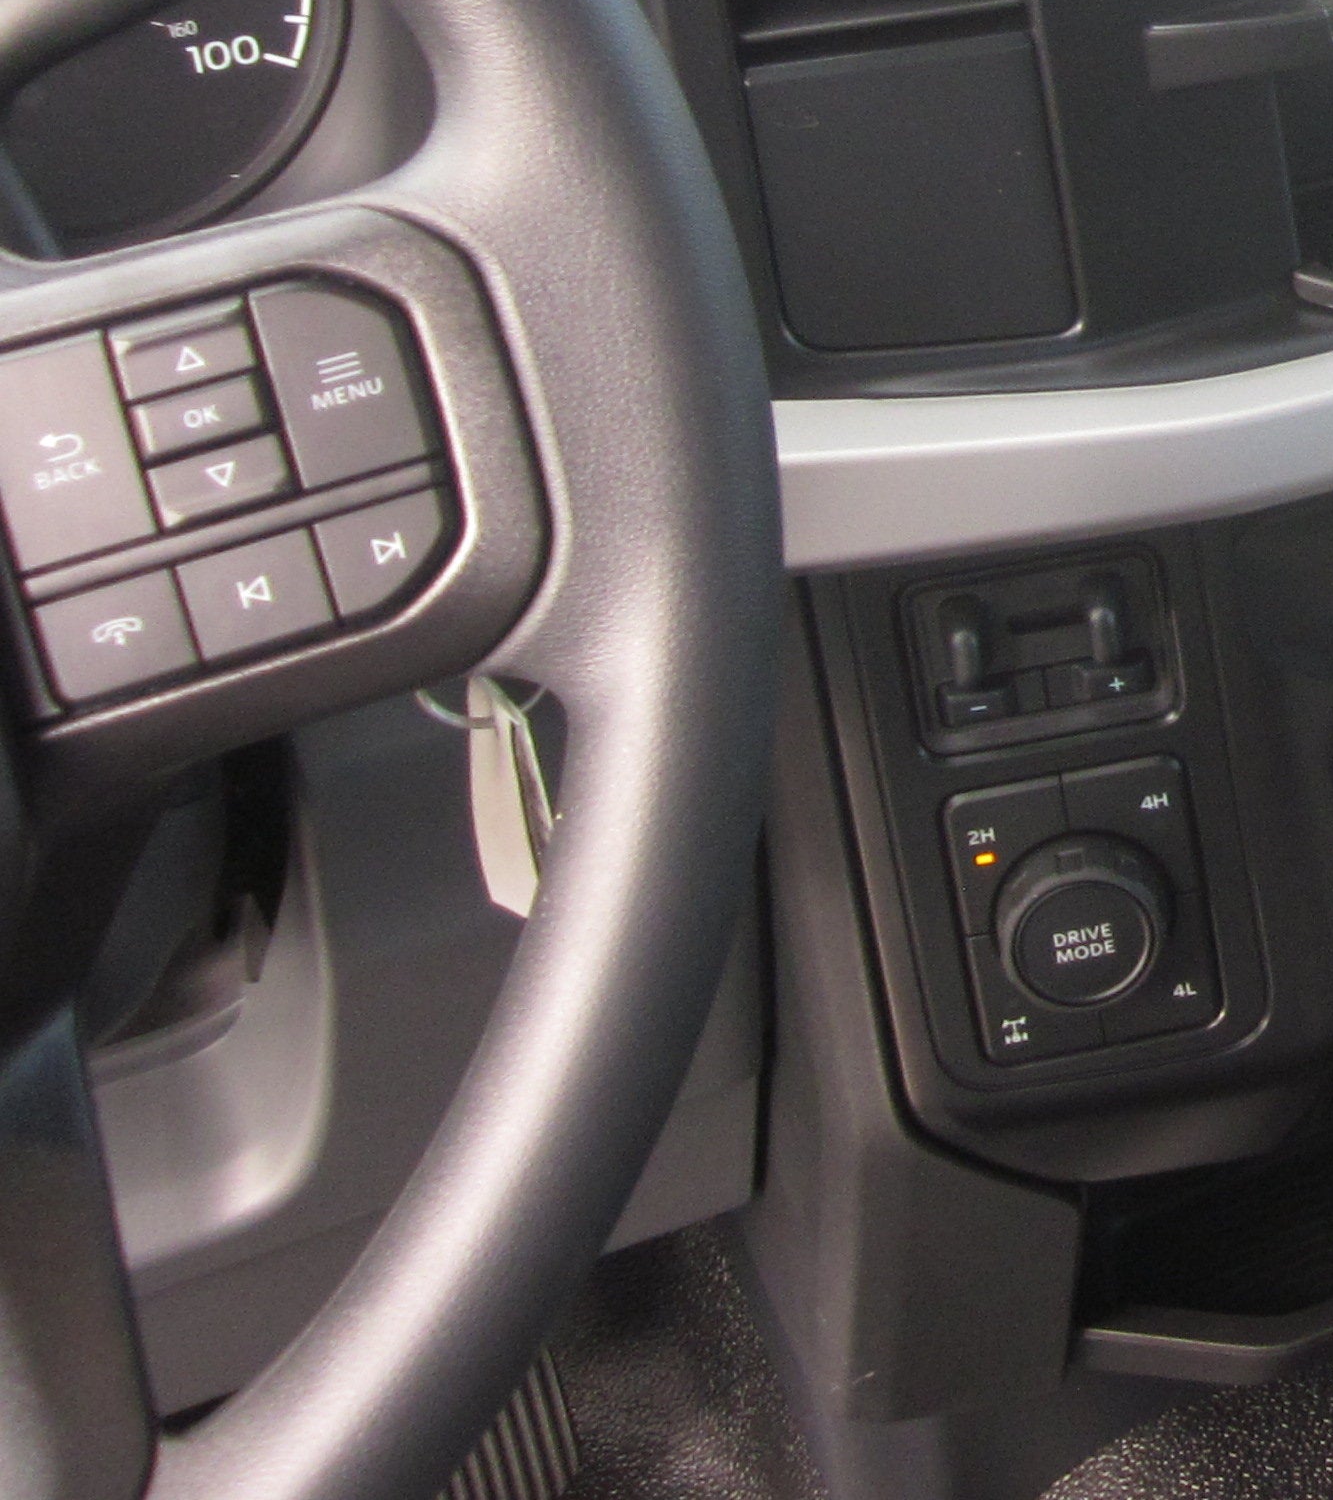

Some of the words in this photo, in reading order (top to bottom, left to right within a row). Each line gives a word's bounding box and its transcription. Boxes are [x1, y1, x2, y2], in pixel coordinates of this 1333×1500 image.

[168, 19, 197, 39] 160
[186, 35, 260, 74] 100
[311, 375, 385, 411] MENU
[183, 405, 222, 429] OK
[35, 458, 102, 491] BACK
[1140, 792, 1170, 811] 4H
[967, 826, 996, 846] 2H
[1052, 923, 1113, 948] DRIVE
[1056, 939, 1116, 965] MODE
[1173, 981, 1198, 999] 4L
